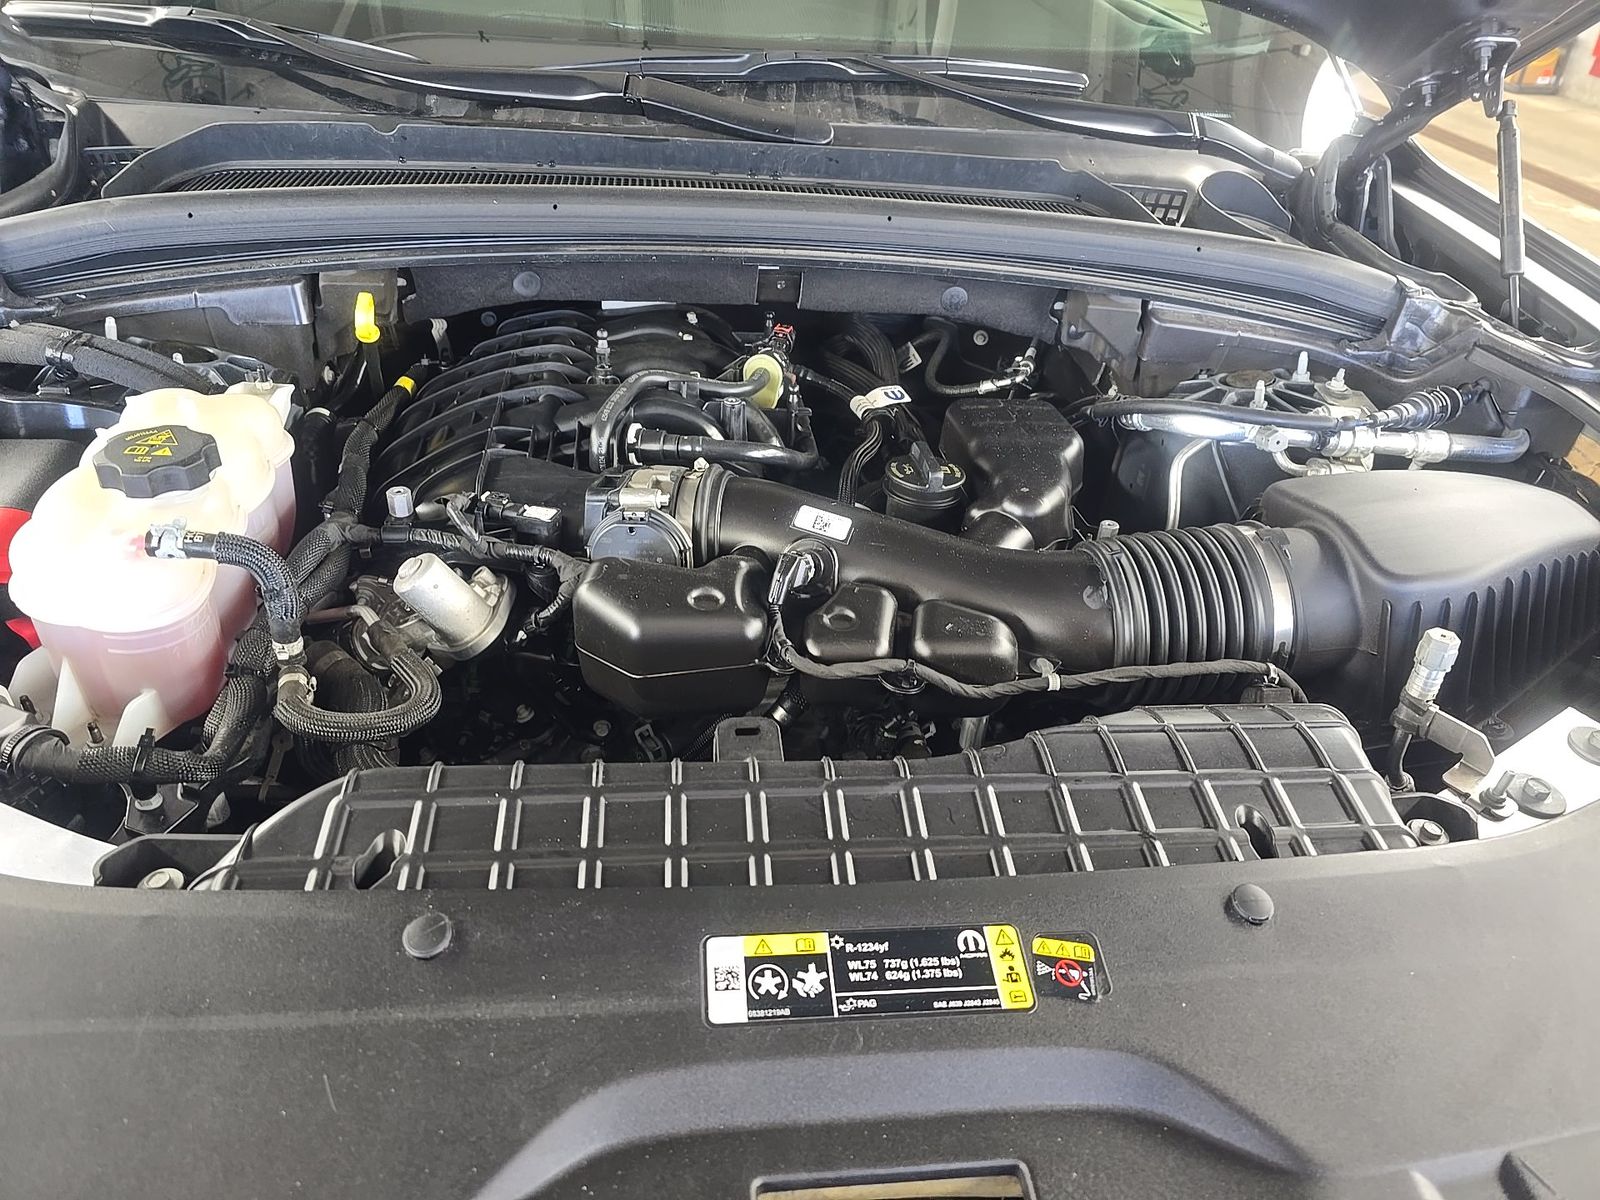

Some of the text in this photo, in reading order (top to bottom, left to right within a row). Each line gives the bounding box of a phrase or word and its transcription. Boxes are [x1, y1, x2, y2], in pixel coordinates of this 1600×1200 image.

[845, 942, 889, 953] R-1234yf
[847, 956, 960, 970] WL75 737g (1.625 lbs)
[848, 968, 963, 982] WL74 624g (1.375 lbs)
[857, 999, 877, 1009] PAG
